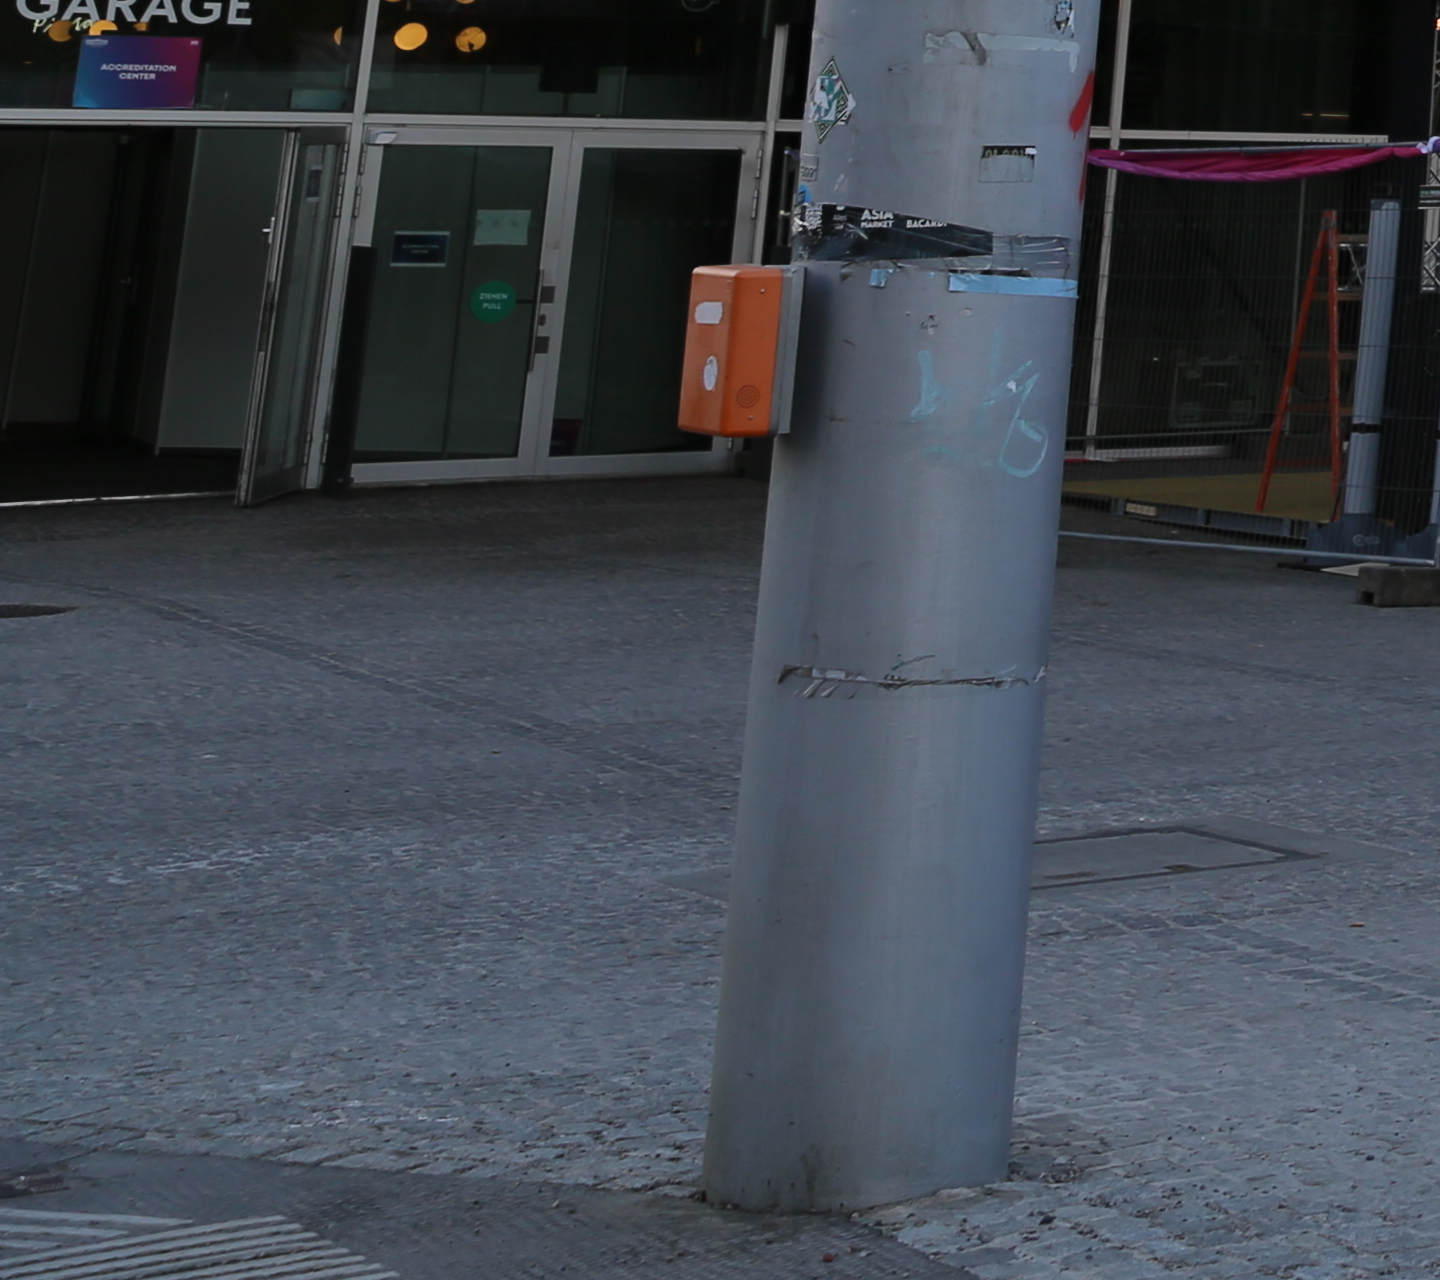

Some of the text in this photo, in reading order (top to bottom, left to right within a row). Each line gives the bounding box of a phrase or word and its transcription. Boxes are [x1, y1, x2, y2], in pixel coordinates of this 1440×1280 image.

[99, 62, 178, 74] ACCREDITATION
[118, 72, 157, 81] CENTER
[860, 208, 895, 221] ASIA
[482, 302, 502, 311] PULL
